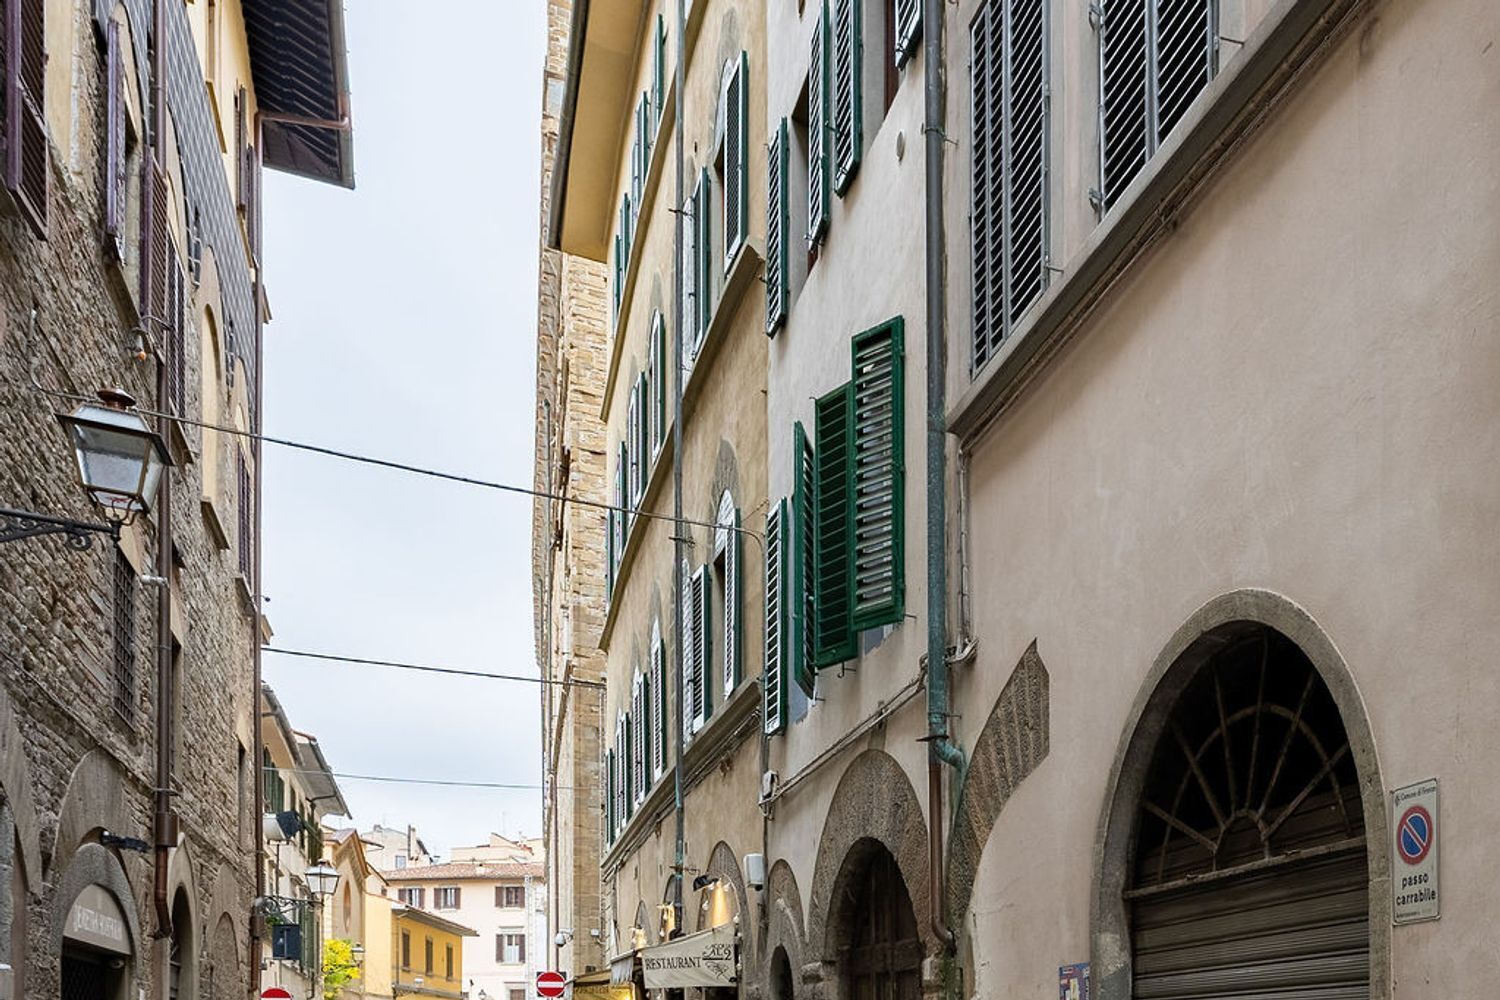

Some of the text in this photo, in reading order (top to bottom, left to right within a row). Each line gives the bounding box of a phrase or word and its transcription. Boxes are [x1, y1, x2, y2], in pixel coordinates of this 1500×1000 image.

[1402, 873, 1429, 890] passo
[1396, 888, 1436, 906] carrabile
[723, 947, 732, 961] 2
[645, 956, 701, 971] RESTAURANT
